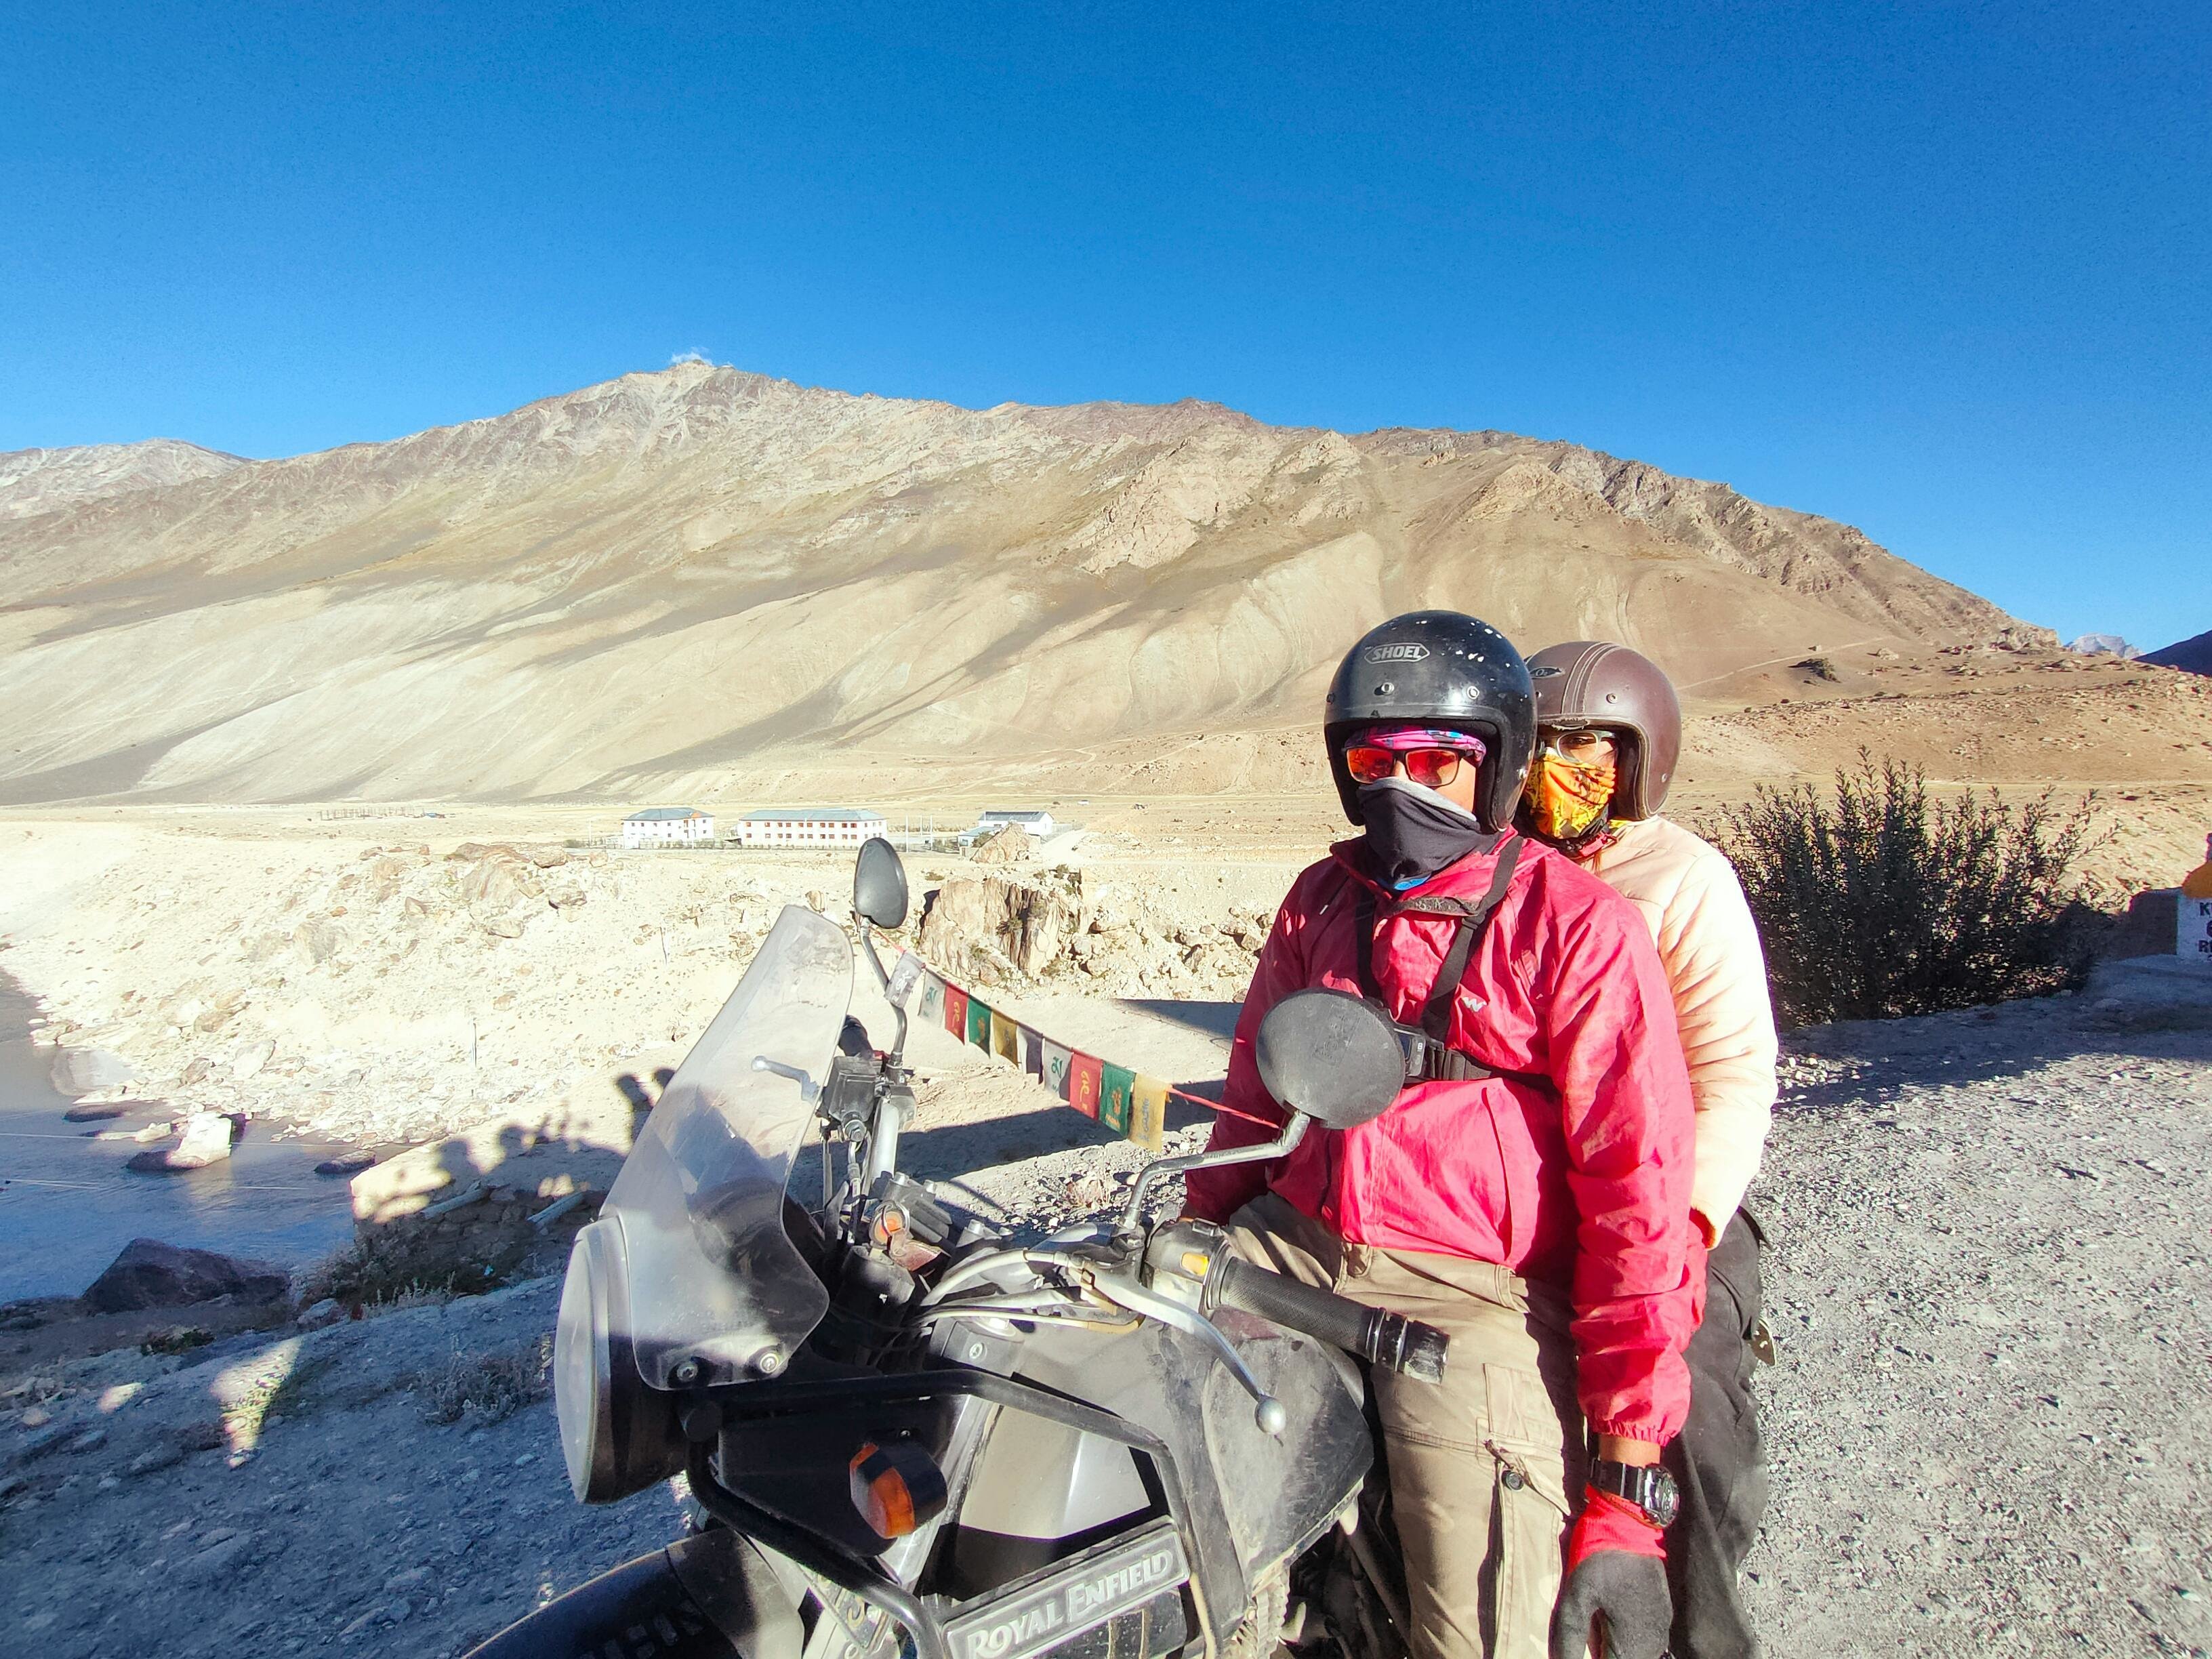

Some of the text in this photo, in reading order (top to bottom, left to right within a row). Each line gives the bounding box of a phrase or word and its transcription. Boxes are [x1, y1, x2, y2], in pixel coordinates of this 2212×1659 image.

[2200, 902, 2212, 916] K
[966, 1549, 1174, 1659] ROYAL ENFIELD
